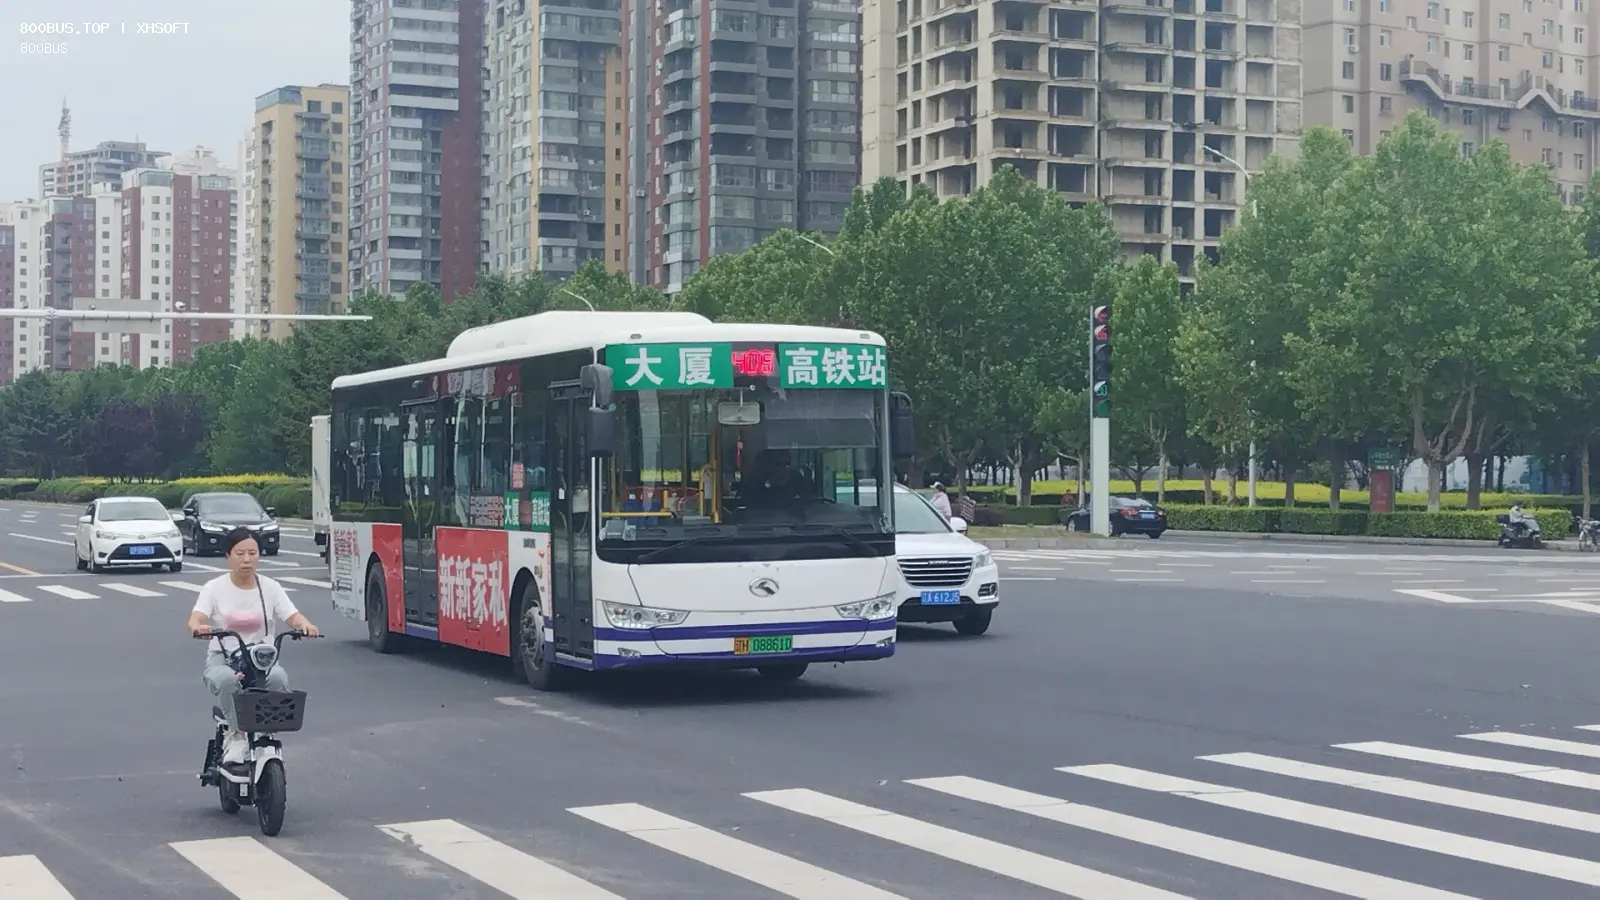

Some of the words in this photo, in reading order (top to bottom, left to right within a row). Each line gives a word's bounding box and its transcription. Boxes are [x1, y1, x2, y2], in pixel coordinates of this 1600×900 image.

[625, 347, 716, 387] 大厦
[785, 347, 886, 386] 高铁站
[438, 553, 507, 628] 新新家私
